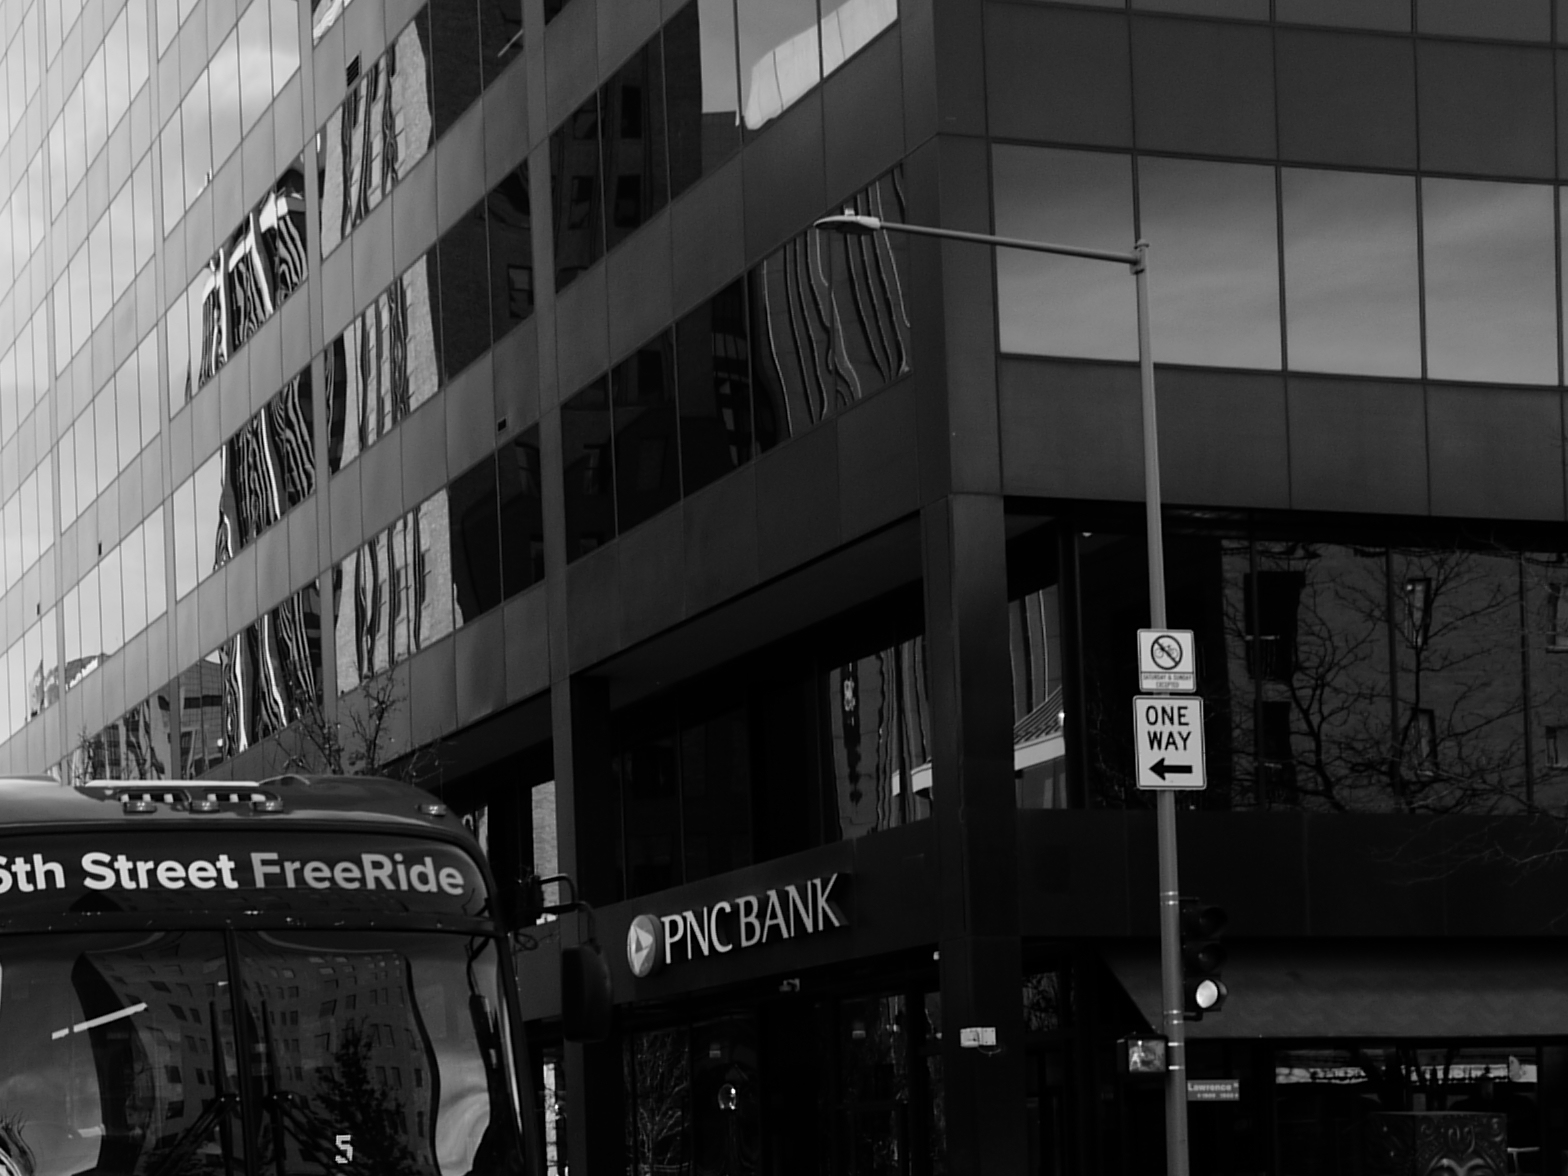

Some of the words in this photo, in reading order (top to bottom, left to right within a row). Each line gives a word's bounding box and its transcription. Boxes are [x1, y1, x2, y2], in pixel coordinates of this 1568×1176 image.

[1146, 705, 1189, 726] ONE
[1147, 730, 1192, 751] WAY
[81, 852, 238, 890] Street
[250, 852, 465, 895] FreeRide
[661, 900, 733, 965] PNC
[735, 872, 841, 949] BANK
[1187, 1082, 1232, 1092] Lawrence
